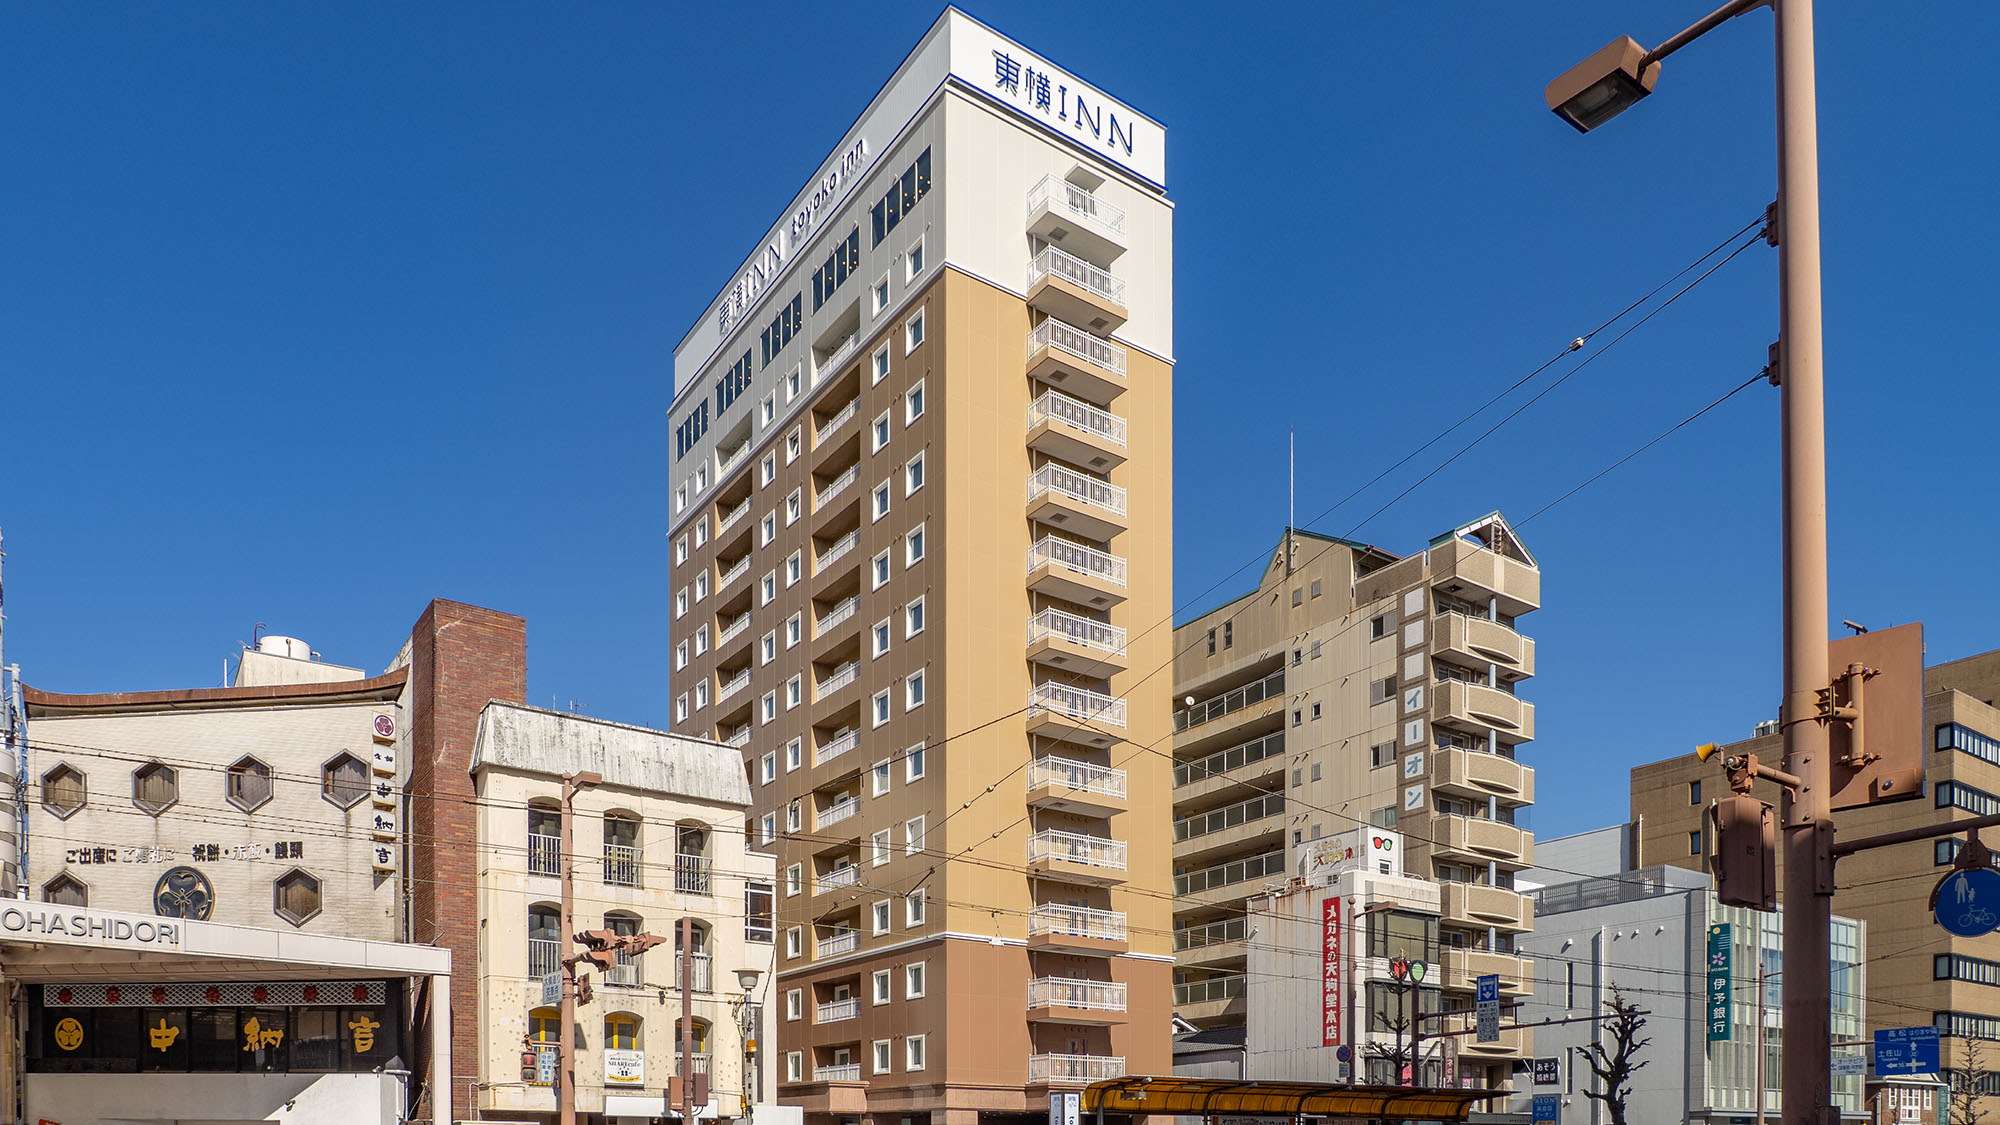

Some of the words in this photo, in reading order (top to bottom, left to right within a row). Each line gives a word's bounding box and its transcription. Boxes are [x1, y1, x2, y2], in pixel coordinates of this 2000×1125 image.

[991, 49, 1133, 157] 東横INN
[790, 172, 839, 237] toyoko
[841, 138, 868, 177] inn
[65, 847, 117, 864] ご出産に
[2, 908, 180, 944] OHASHIDORI
[1326, 904, 1338, 1040] メガネの天狗堂本店
[1713, 978, 1726, 1033] 伊予銀行
[1537, 1063, 1556, 1071] あそう
